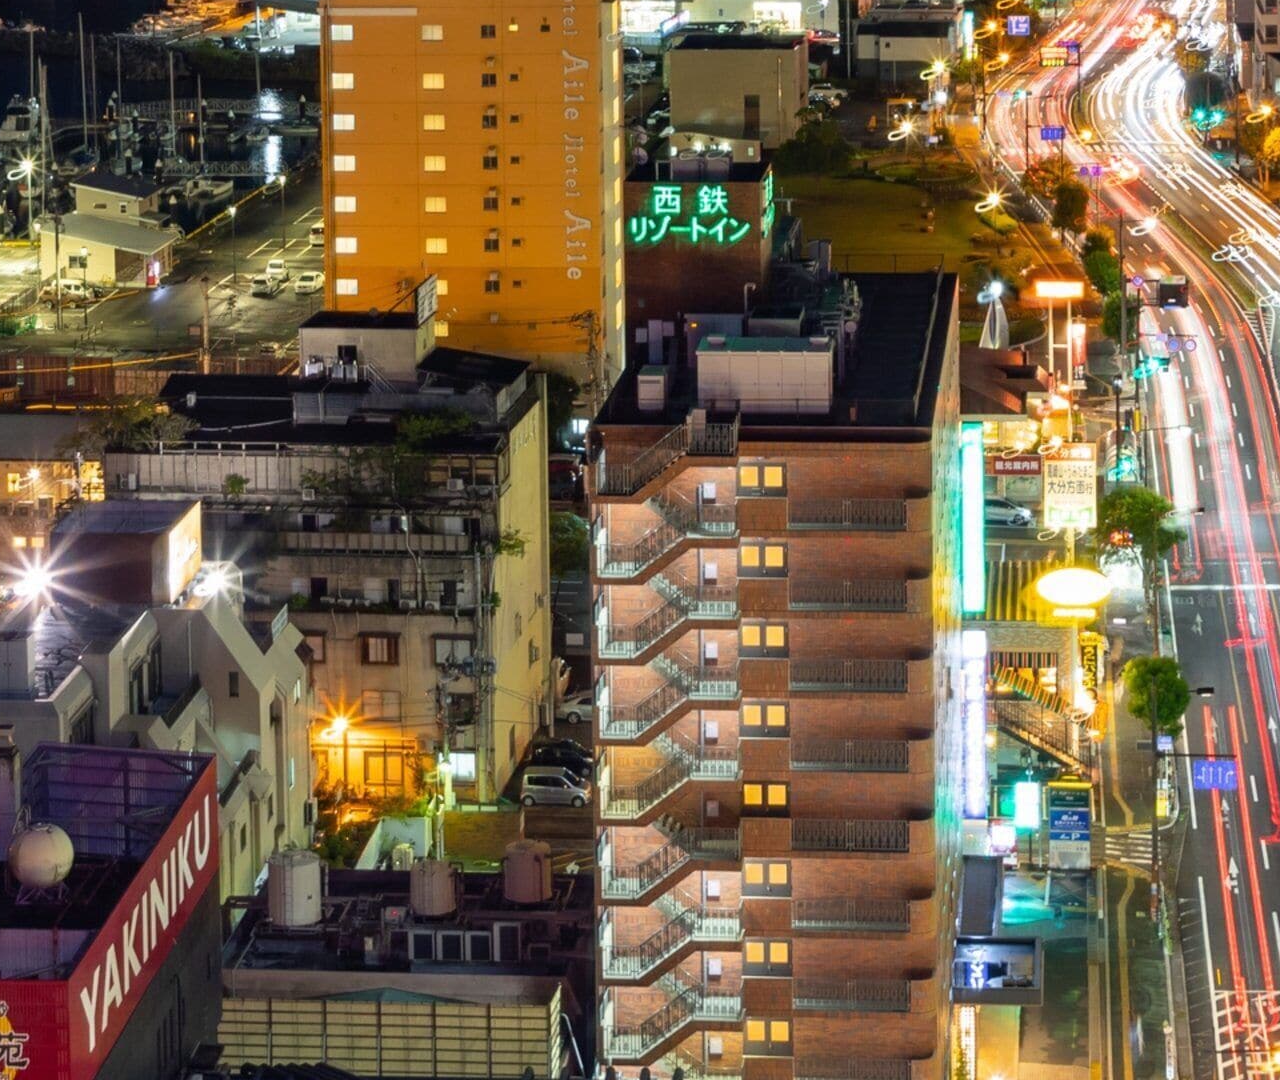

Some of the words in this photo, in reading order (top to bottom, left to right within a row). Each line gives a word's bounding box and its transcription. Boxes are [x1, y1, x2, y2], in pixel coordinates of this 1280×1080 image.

[562, 49, 590, 120] Aile
[563, 133, 584, 198] Hotel
[631, 216, 751, 243] リゾートイン
[653, 186, 729, 215] 西鉄
[564, 209, 592, 280] Aile
[79, 793, 212, 1055] YAKINIKU
